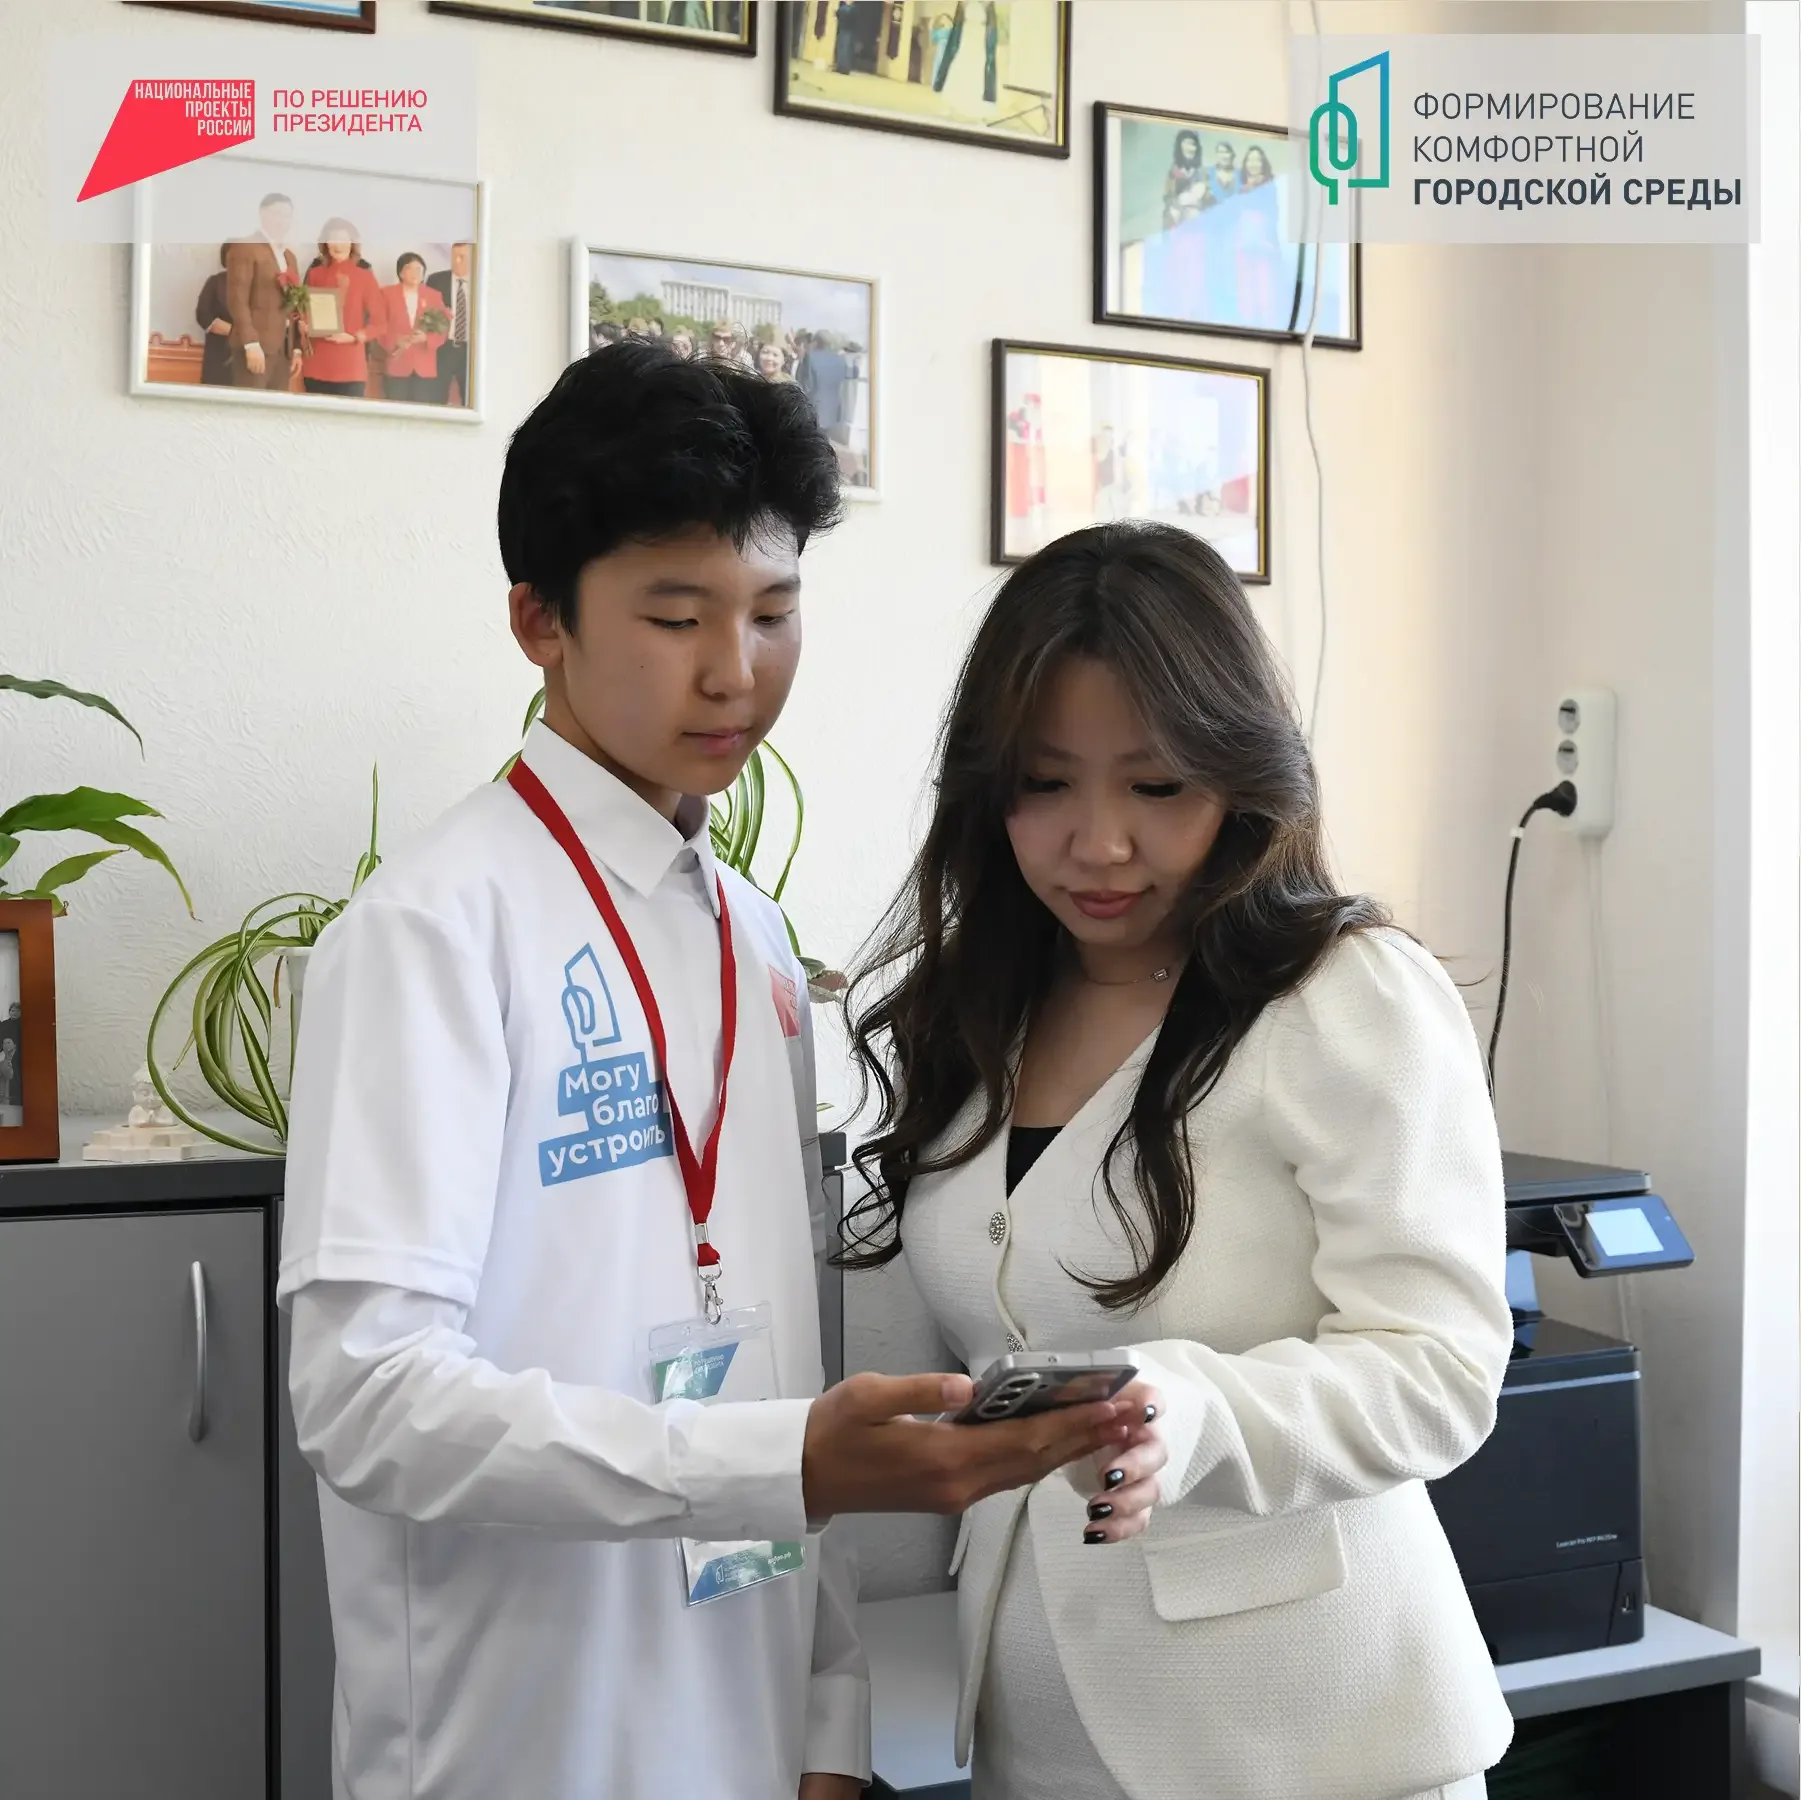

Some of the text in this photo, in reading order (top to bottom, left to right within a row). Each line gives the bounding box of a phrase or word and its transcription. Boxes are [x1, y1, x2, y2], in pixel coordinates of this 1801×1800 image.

[565, 1063, 640, 1098] Могу
[592, 1093, 660, 1126] благо
[547, 1125, 666, 1177] устроить
